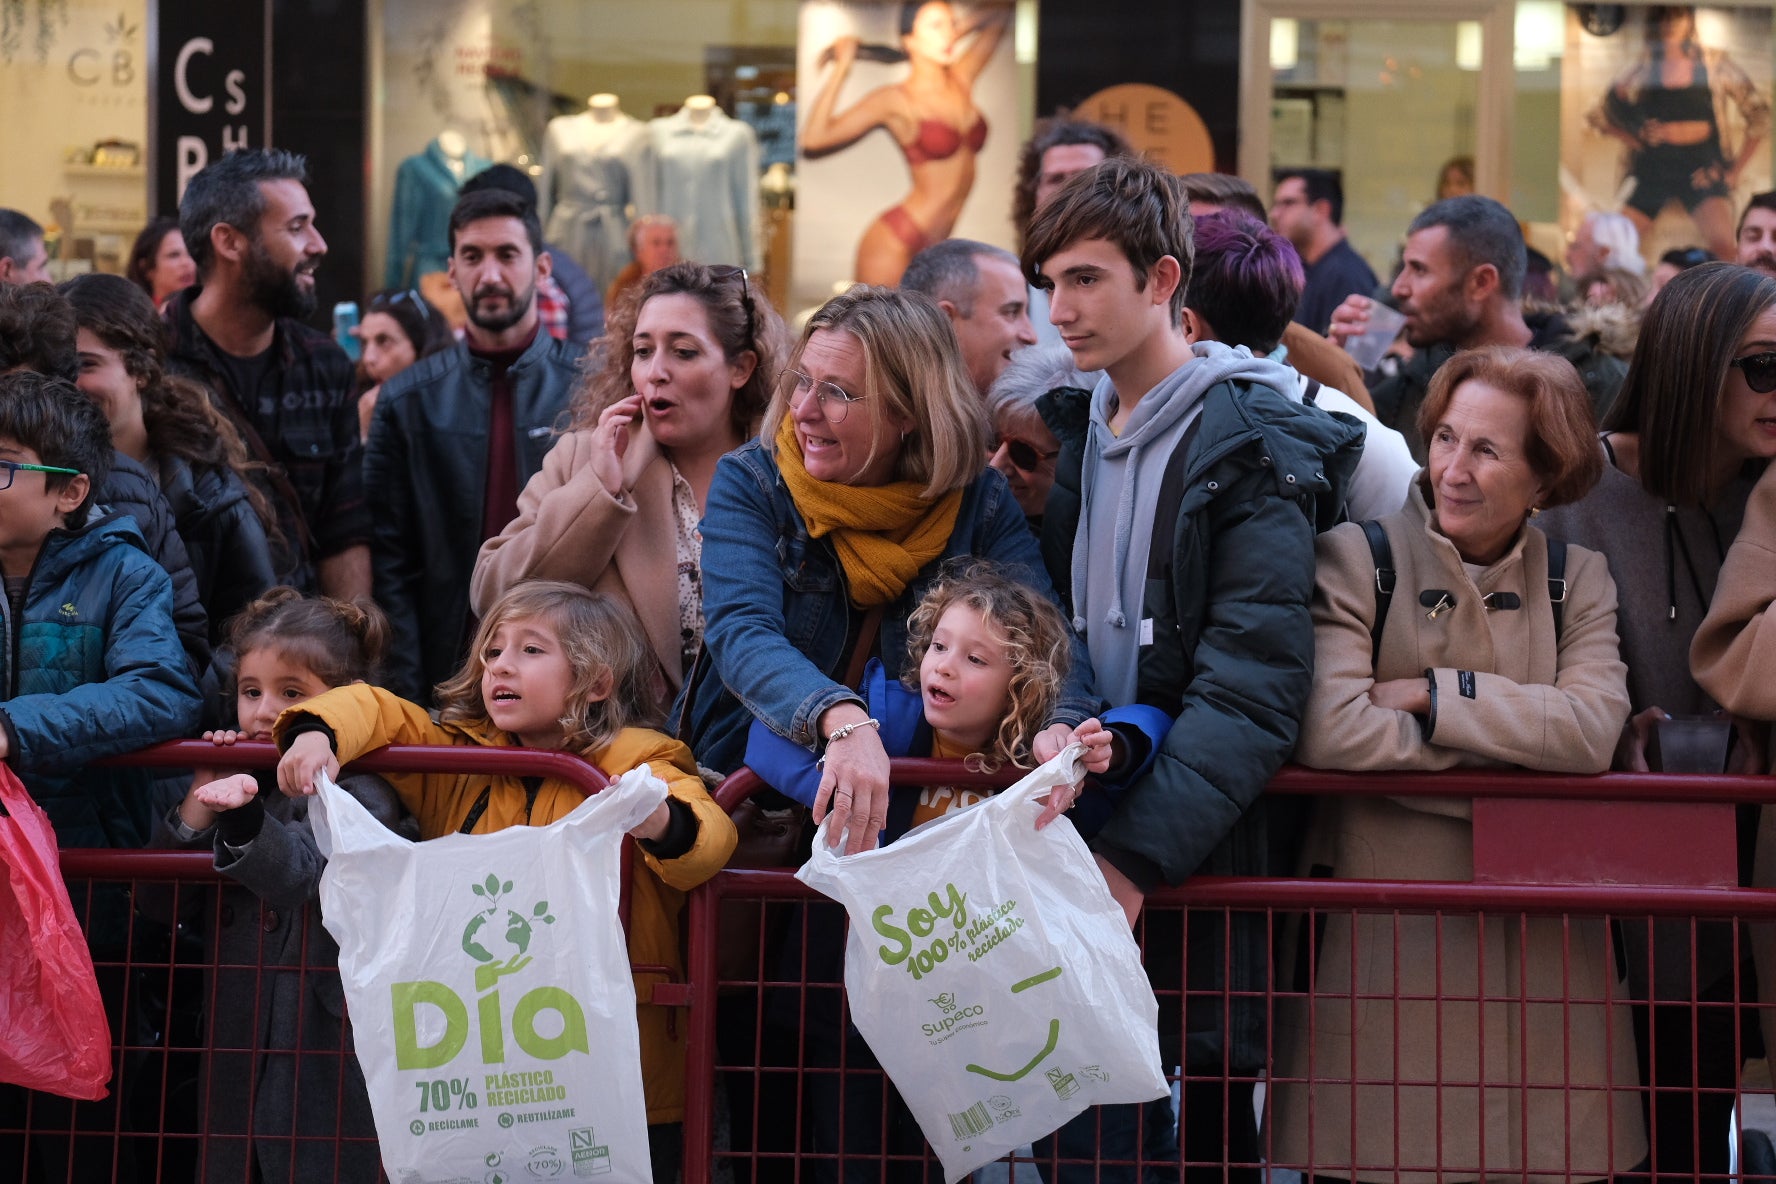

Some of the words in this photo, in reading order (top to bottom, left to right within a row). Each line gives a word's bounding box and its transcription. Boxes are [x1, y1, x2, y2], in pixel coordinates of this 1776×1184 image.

[872, 883, 967, 965] Soy
[907, 931, 966, 980] 100%
[966, 900, 1016, 944] plástico
[968, 917, 1024, 962] reciclado
[922, 1005, 983, 1037] Supeco
[485, 1070, 554, 1090] PLÁSTICO
[416, 1078, 478, 1113] 70%
[486, 1085, 566, 1107] RECICLADO
[428, 1118, 480, 1132] RECÍCLAME
[517, 1108, 576, 1124] REUTILÍZAME
[533, 1160, 559, 1170] 70%
